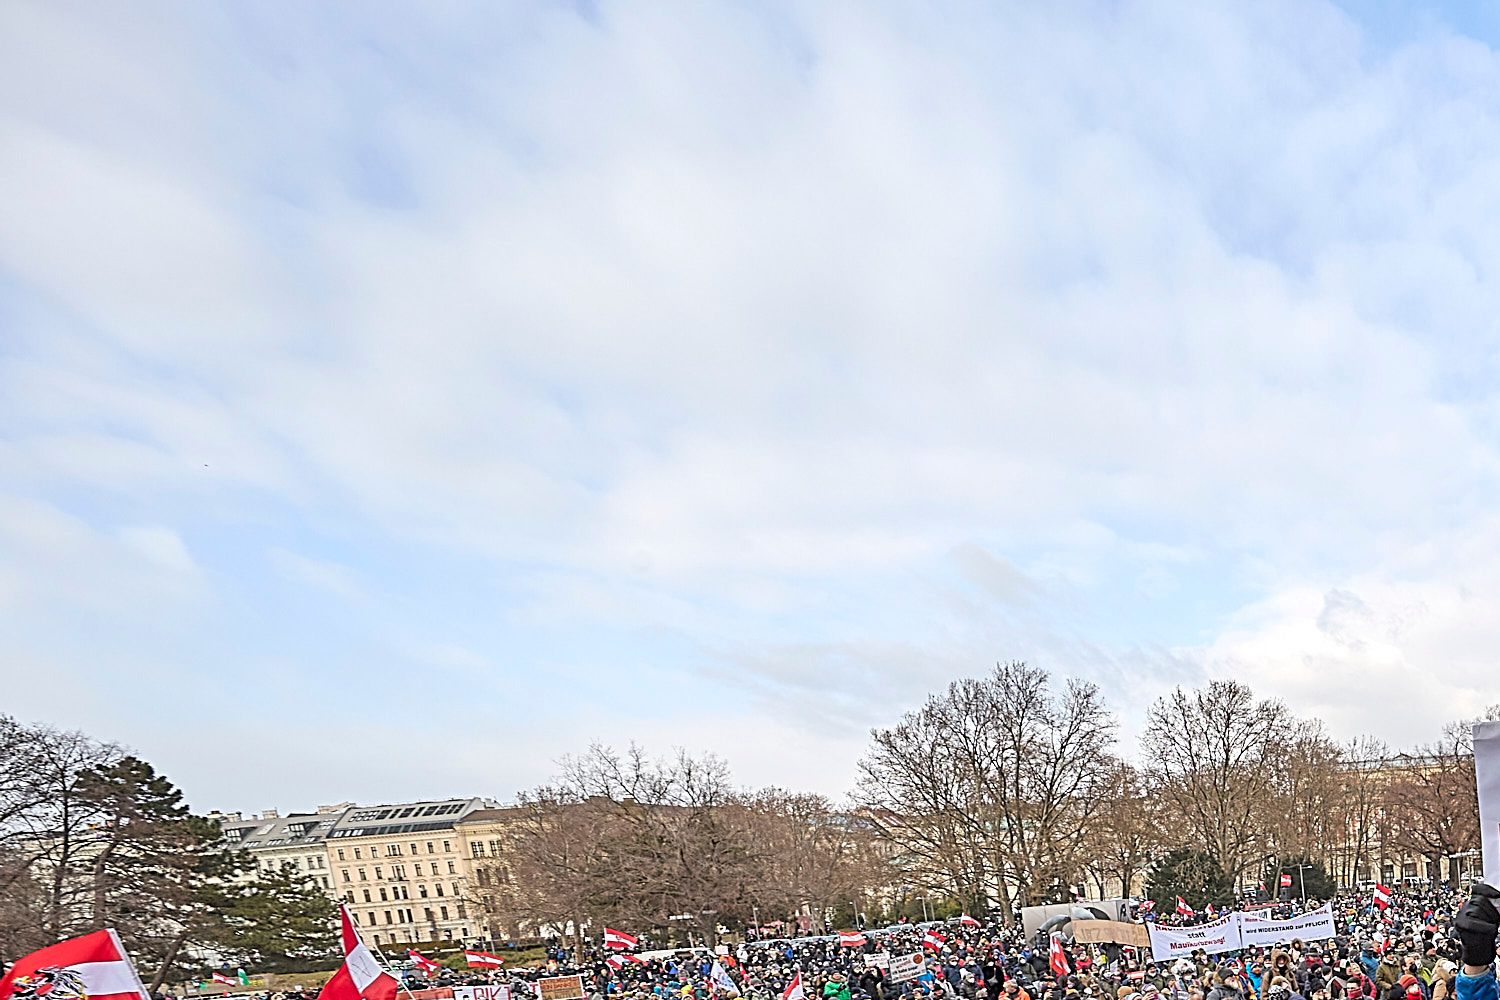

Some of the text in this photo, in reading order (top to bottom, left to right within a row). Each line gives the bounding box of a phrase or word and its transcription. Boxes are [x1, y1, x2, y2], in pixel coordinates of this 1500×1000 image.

[1258, 925, 1294, 933] WIDERSTAND
[1305, 919, 1329, 928] PFLICHT
[1187, 931, 1206, 939] statt
